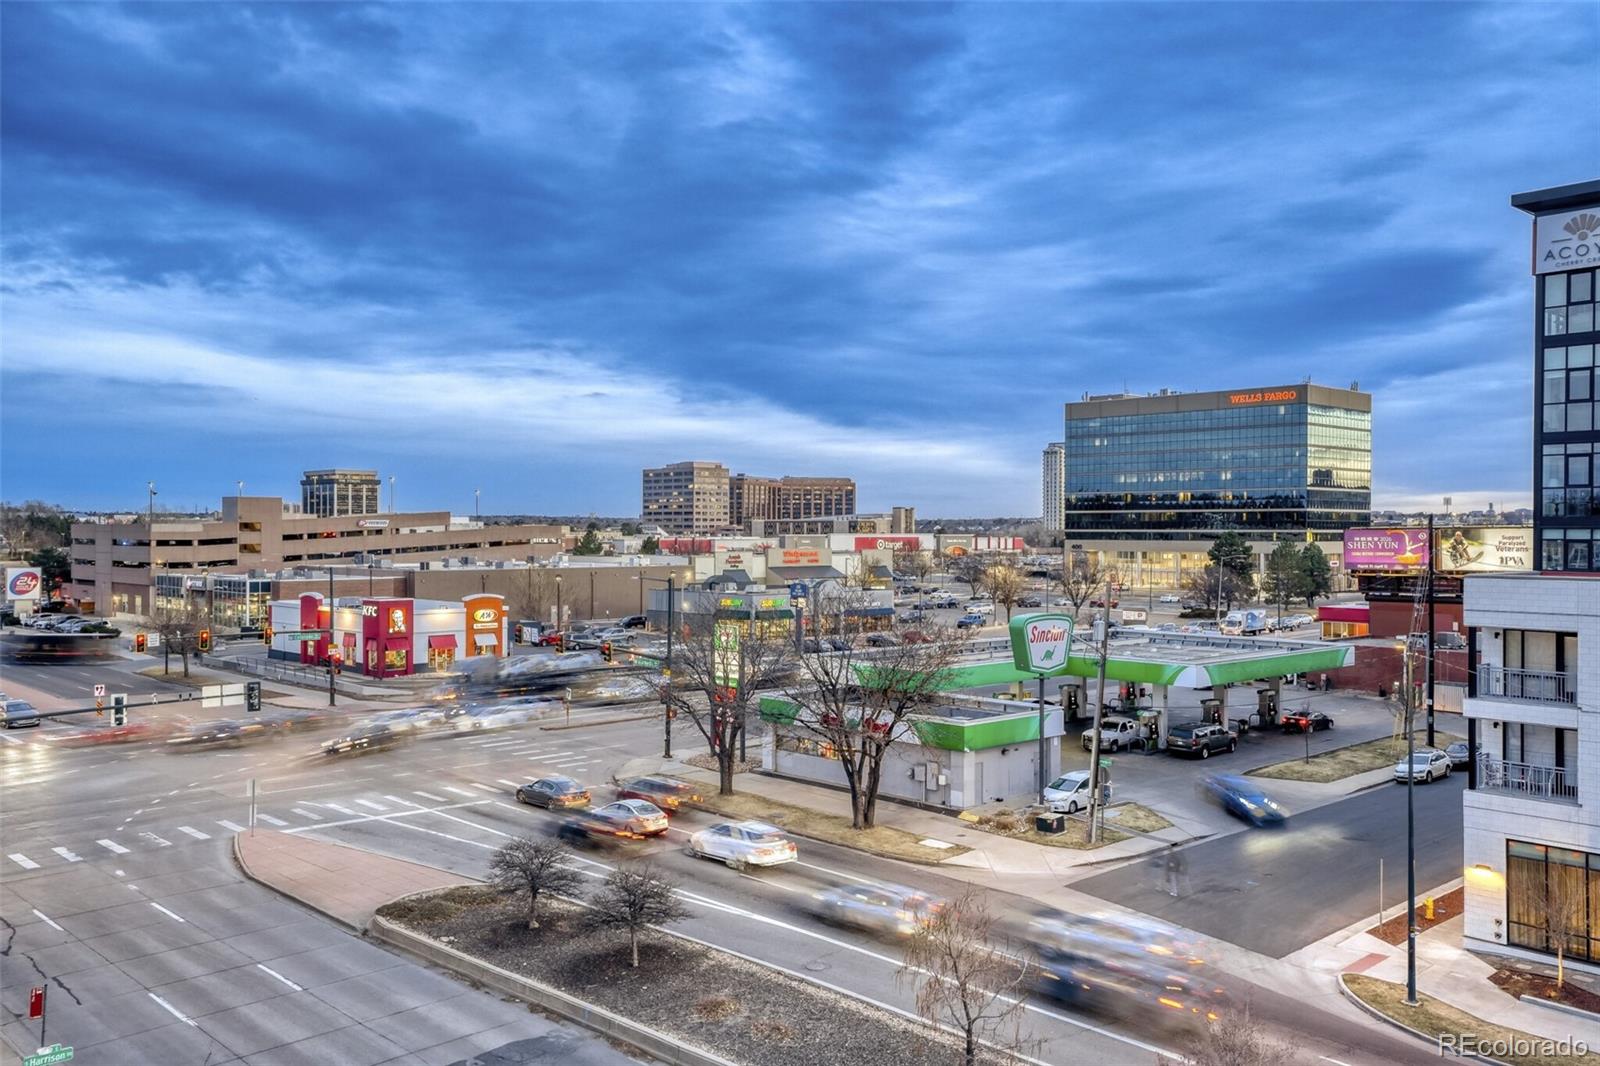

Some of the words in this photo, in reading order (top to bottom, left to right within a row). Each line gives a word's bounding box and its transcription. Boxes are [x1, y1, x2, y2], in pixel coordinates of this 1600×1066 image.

[1230, 392, 1262, 404] WELLS
[1263, 390, 1297, 401] FARGO
[1347, 541, 1375, 550] SHEN
[1377, 541, 1399, 550] YUN
[1504, 556, 1525, 566] PVA
[16, 576, 37, 589] 24
[362, 605, 378, 617] KFC
[1030, 624, 1066, 644] Sinclair
[30, 1053, 66, 1066] Harrison
